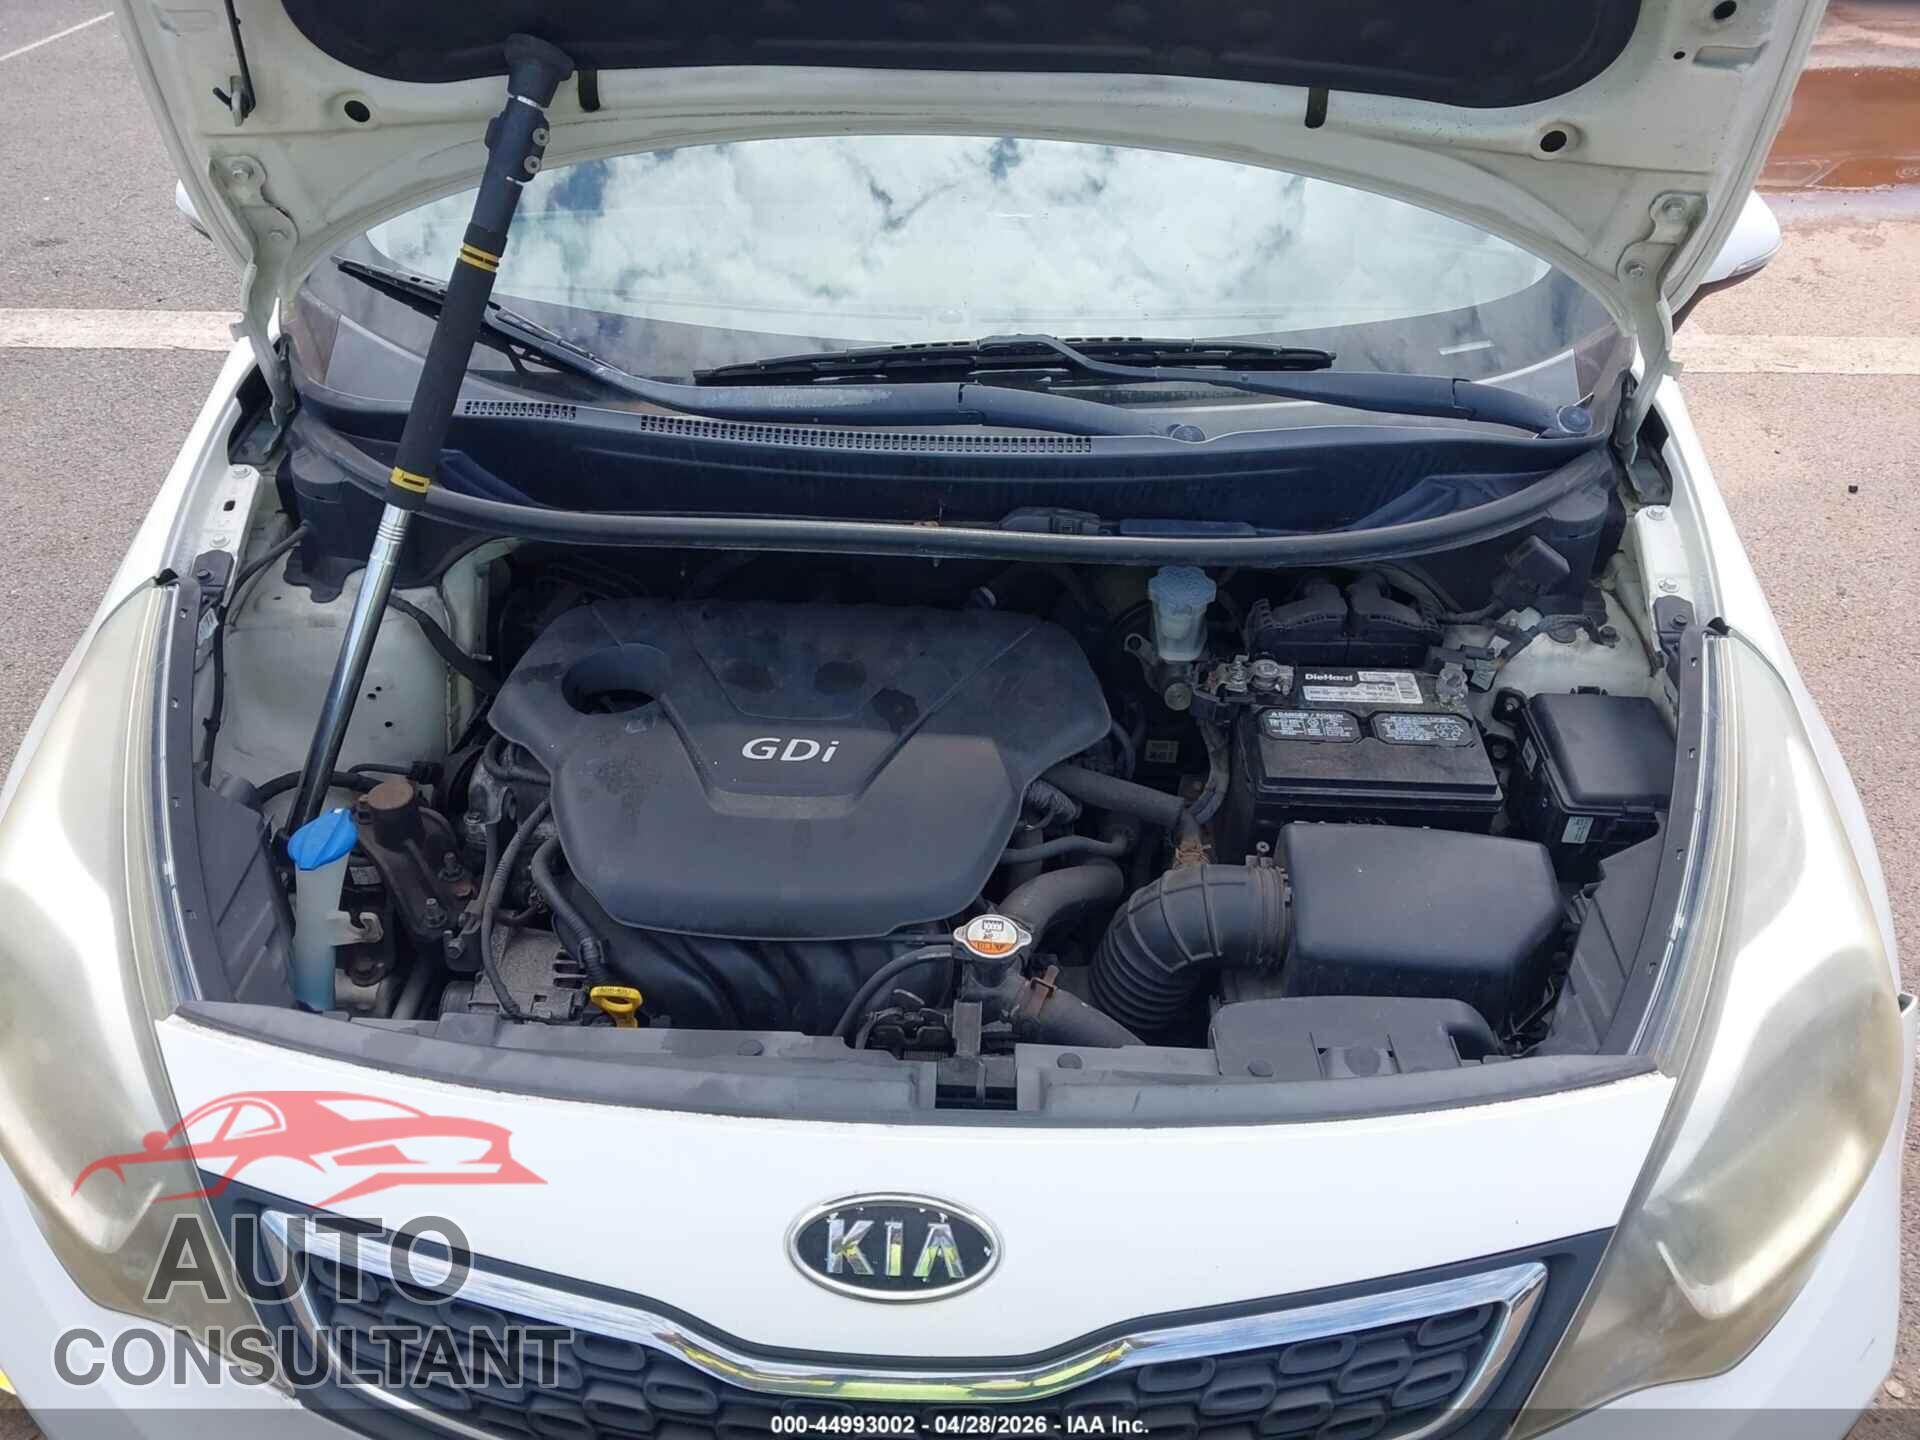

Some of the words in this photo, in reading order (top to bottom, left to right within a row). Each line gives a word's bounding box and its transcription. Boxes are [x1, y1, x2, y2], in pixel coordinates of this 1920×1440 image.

[1305, 673, 1353, 681] DieHard
[742, 737, 840, 763] GDi
[826, 1217, 966, 1279] KIA
